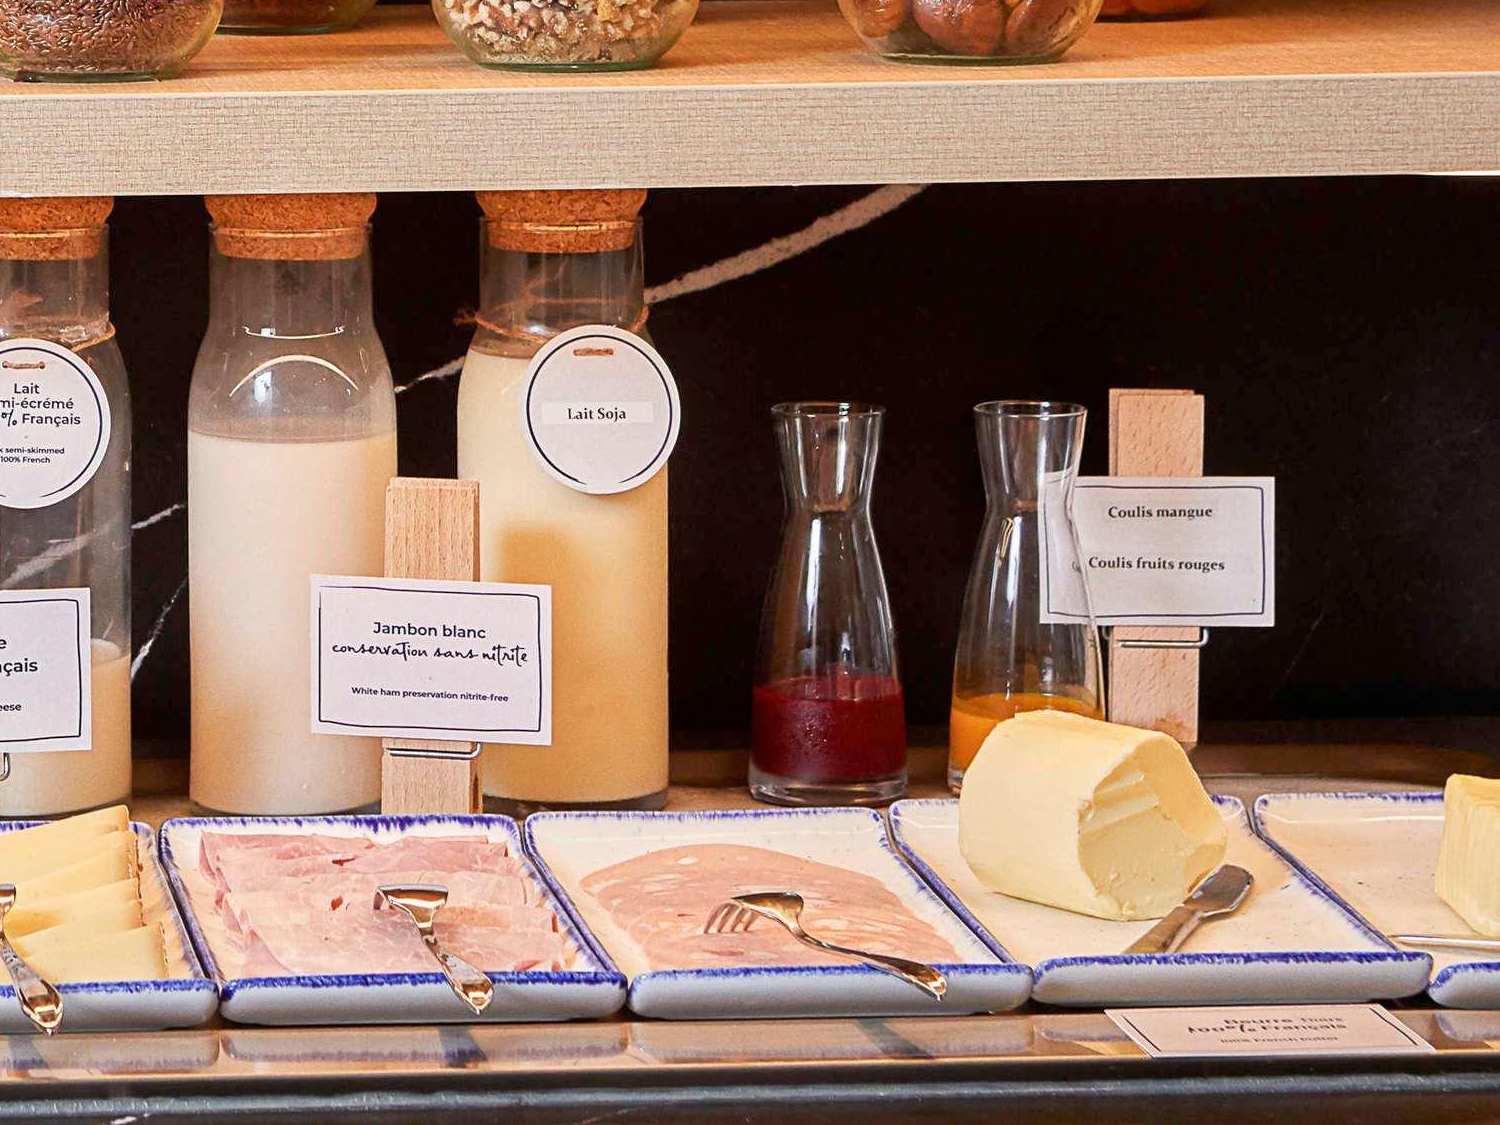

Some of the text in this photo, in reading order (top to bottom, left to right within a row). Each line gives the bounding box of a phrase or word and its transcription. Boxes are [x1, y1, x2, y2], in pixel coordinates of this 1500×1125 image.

[14, 382, 40, 394] Lait
[1, 409, 17, 427] %
[22, 413, 81, 427] Français
[568, 407, 626, 422] Lait Soja
[5, 446, 65, 454] semi-skimmed
[1108, 506, 1213, 520] Coulis mangue
[1088, 556, 1225, 573] Coulis fruits rouges
[372, 622, 486, 639] Jambon blanc
[332, 641, 528, 666] conservation sans nitrite
[351, 686, 509, 702] White ham preservation nitrite-free
